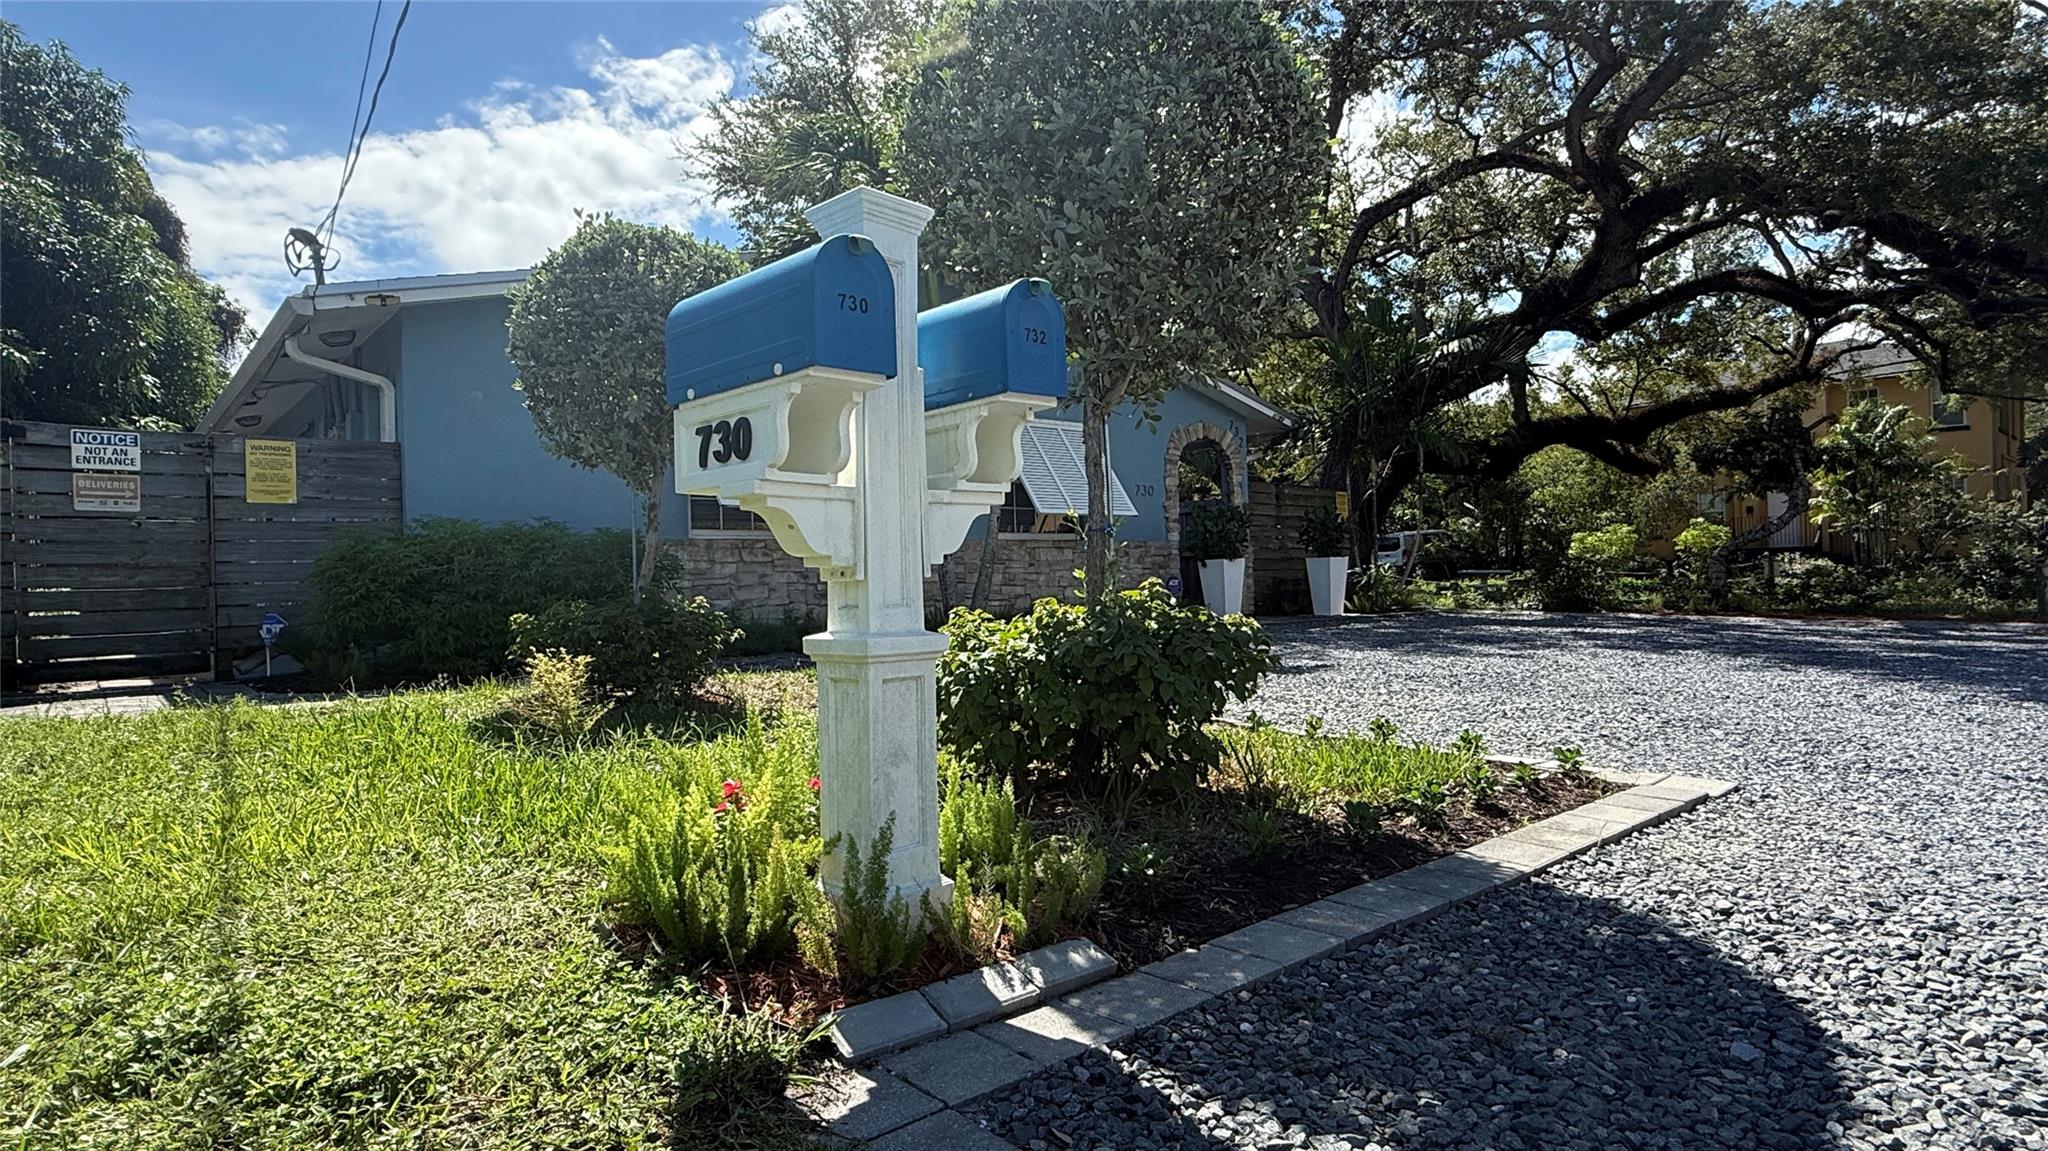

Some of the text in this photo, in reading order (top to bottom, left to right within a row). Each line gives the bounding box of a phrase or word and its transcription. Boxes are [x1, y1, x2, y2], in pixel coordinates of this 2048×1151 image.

[837, 293, 868, 314] 730
[1024, 327, 1046, 345] 732
[75, 432, 136, 446] NOTICE
[1229, 420, 1244, 448] 732
[250, 444, 292, 453] WARNING
[695, 417, 752, 468] 730
[84, 446, 128, 456] NOT AN
[76, 455, 137, 467] ENTRANCE
[78, 480, 136, 489] DELIVERIES
[1135, 484, 1154, 497] 730
[262, 624, 284, 639] DT
